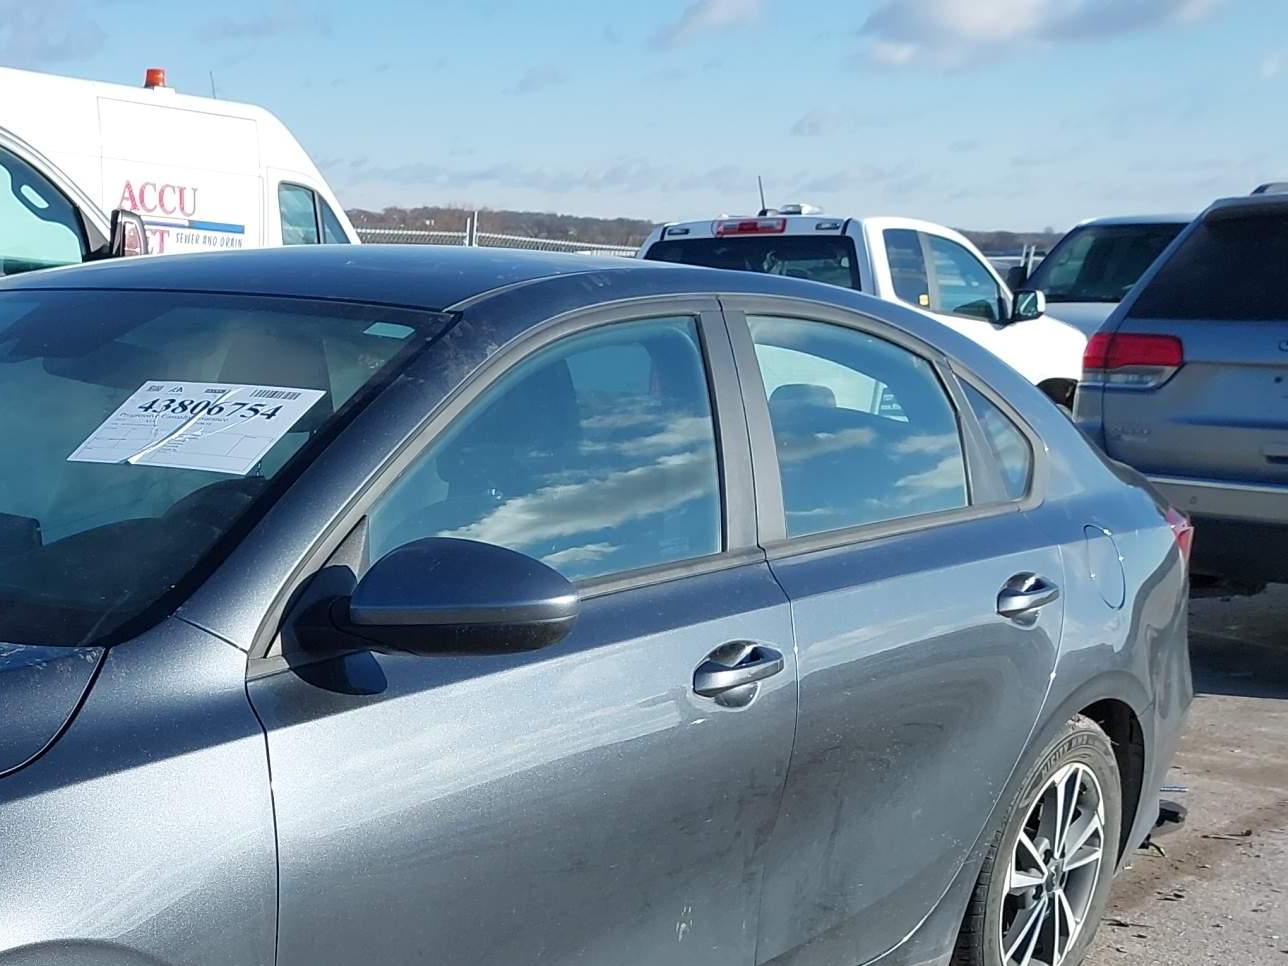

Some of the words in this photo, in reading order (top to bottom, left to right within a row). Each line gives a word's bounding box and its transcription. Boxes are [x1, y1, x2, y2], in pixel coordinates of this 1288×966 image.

[117, 180, 199, 217] ACCU
[175, 231, 201, 245] SEWER
[202, 234, 218, 247] AND
[219, 236, 243, 249] DRAIN
[137, 398, 285, 421] 43806754
